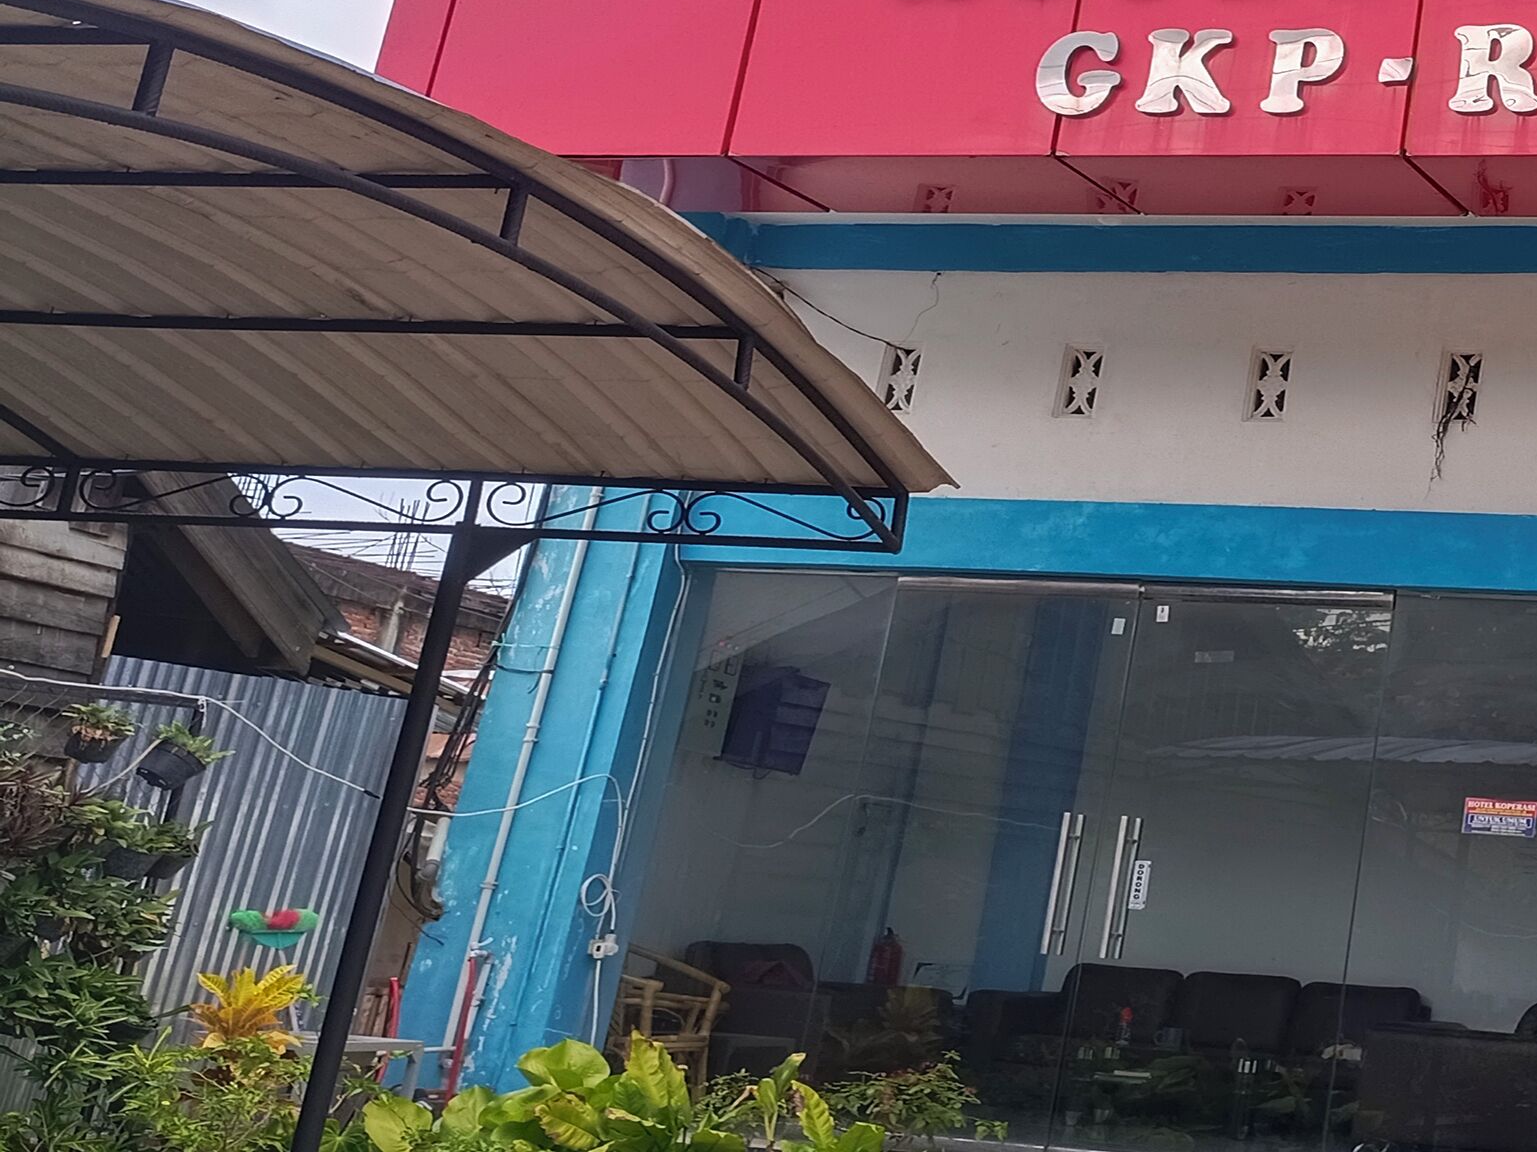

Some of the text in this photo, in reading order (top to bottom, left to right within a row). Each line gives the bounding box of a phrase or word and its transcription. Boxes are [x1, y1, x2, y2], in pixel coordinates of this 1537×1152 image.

[1467, 800, 1536, 811] HOTEL KOPERASI
[1133, 863, 1145, 900] DORONG
